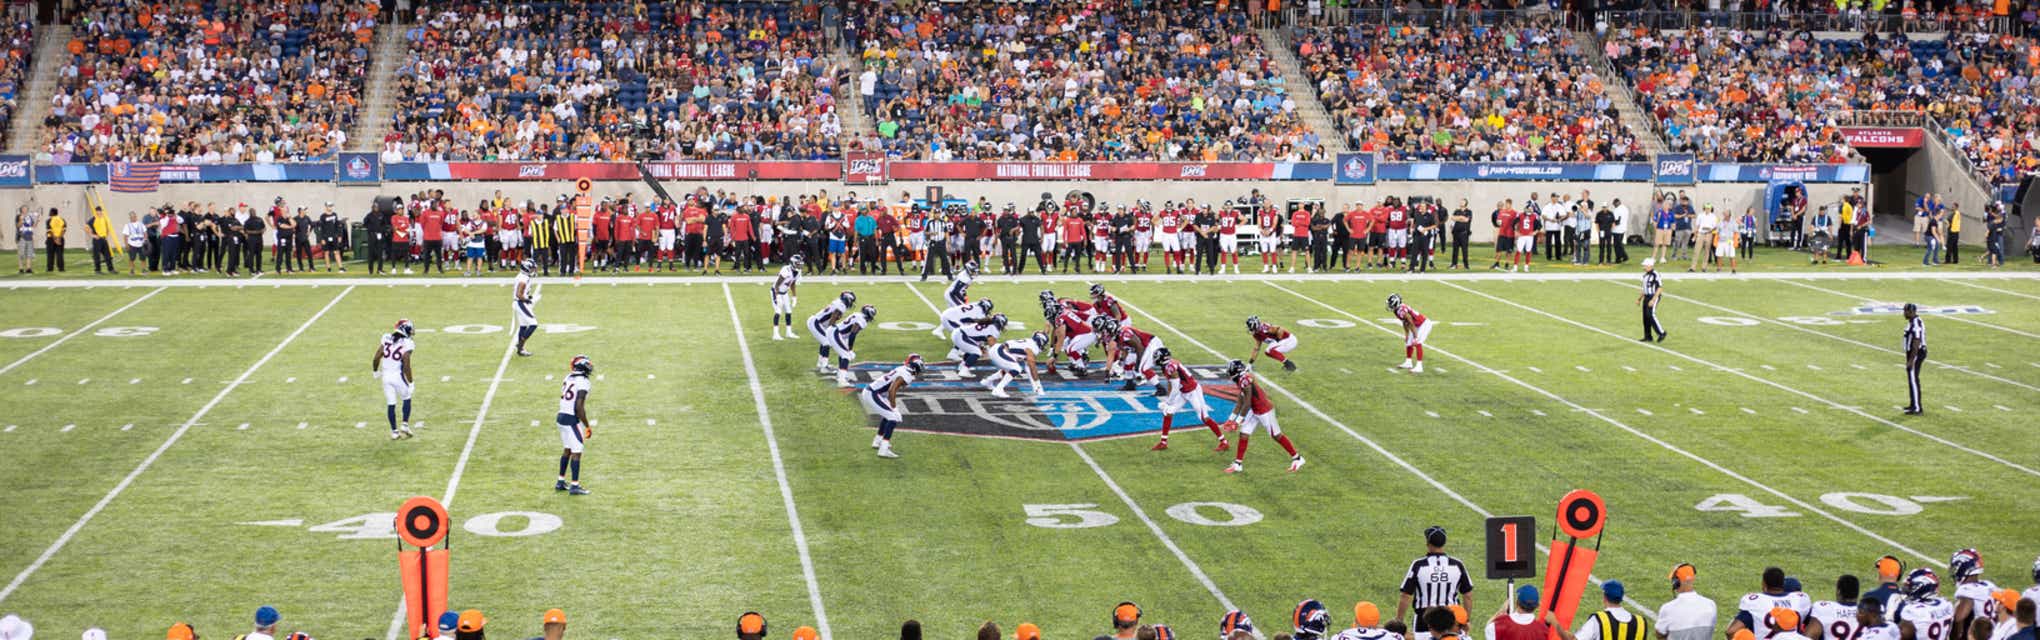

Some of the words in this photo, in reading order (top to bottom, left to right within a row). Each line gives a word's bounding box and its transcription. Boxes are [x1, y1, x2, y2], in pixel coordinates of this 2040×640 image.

[1846, 135, 1905, 143] FALCONS
[674, 163, 708, 177] FOOTBALL
[709, 163, 736, 177] LEAGUE
[996, 163, 1031, 177] NATIONAL
[1031, 163, 1065, 177] FOOTBALL
[1066, 163, 1092, 177] LEAGUE
[384, 341, 403, 361] 36
[1501, 522, 1517, 562] 1
[1430, 572, 1449, 583] 68
